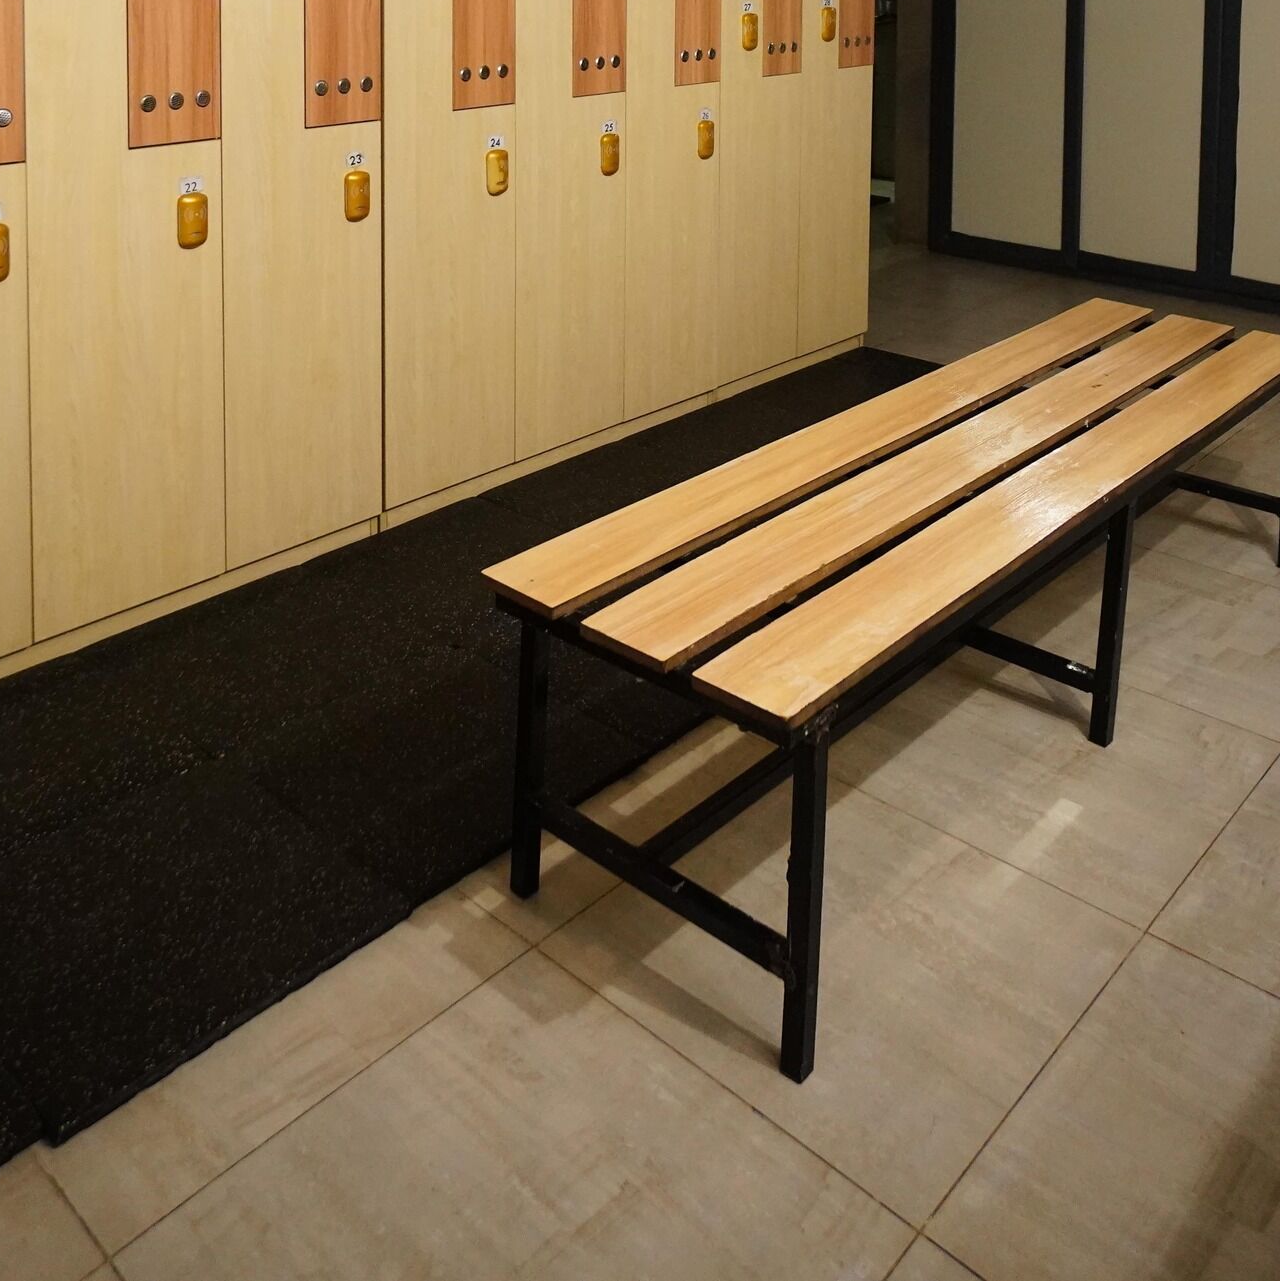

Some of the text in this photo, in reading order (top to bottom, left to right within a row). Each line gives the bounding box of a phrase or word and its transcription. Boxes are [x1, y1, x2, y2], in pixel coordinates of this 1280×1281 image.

[743, 3, 752, 12] 27
[604, 123, 614, 133] 25
[490, 138, 501, 148] 24
[349, 154, 362, 166] 23
[185, 181, 197, 193] 22
